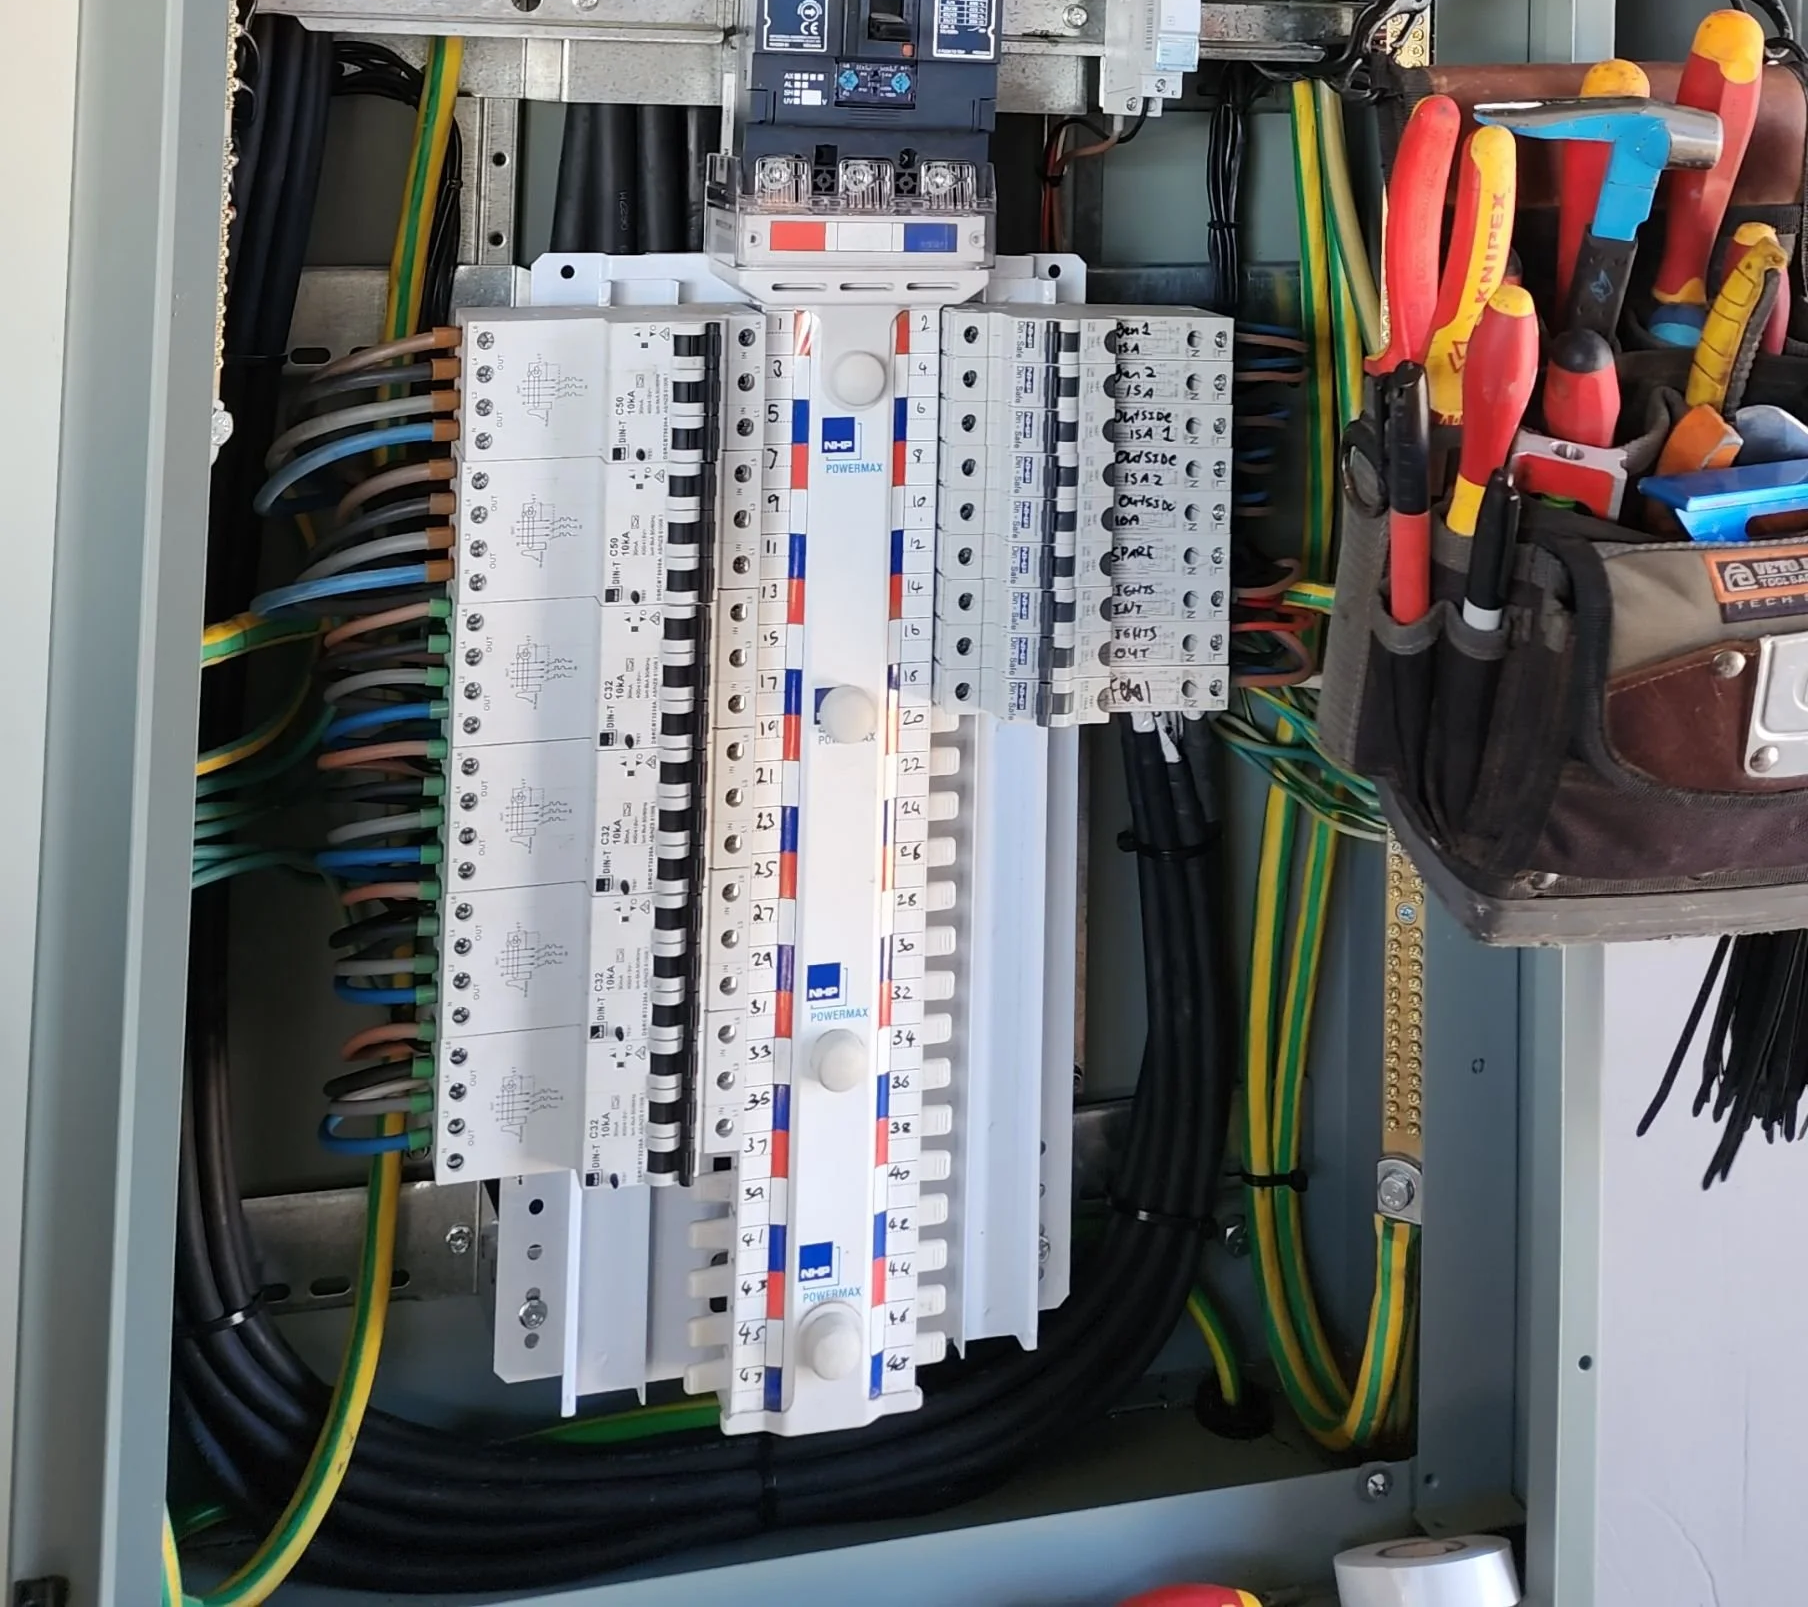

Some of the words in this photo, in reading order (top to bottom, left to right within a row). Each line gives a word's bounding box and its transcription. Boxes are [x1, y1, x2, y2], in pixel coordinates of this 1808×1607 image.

[800, 21, 819, 35] CE
[1475, 193, 1505, 303] KNIPEX
[921, 315, 930, 331] 2
[1143, 322, 1152, 336] 1
[773, 360, 782, 377] 3
[919, 361, 927, 375] 4
[1145, 367, 1157, 379] 2
[616, 396, 624, 416] C50
[627, 390, 636, 414] 10kA
[917, 403, 926, 414] 6
[768, 404, 780, 423] 5
[618, 420, 627, 443] DIN-T
[1162, 426, 1176, 442] 1
[824, 441, 852, 451] NHP
[767, 448, 778, 469] 7
[826, 462, 883, 474] POWERMAX
[1153, 473, 1163, 486] 2
[768, 494, 780, 512] 9
[912, 495, 926, 507] 10
[610, 537, 619, 557] C50
[621, 531, 631, 556] 10kA
[766, 540, 777, 554] 11
[910, 537, 926, 550] 12
[489, 553, 497, 569] OUT
[1110, 544, 1155, 562] SPARE
[612, 561, 621, 585] DIN-T
[1752, 559, 1800, 575] VETO
[907, 579, 924, 593] 14
[1760, 577, 1790, 587] TOOL
[762, 583, 778, 599] 13
[1113, 602, 1143, 615] INT
[1736, 596, 1794, 610] TECH
[764, 631, 779, 646] 15
[905, 624, 920, 638] 16
[1114, 647, 1150, 659] OUT
[604, 680, 613, 700] C32
[615, 674, 625, 699] 10kA
[761, 674, 778, 690] 17
[606, 705, 615, 728] DIN-T
[903, 710, 924, 725] 20
[760, 720, 779, 738] 19
[900, 758, 925, 772] 22
[756, 767, 773, 784] 21
[481, 780, 489, 797] OUT
[901, 801, 921, 814] 24
[756, 813, 775, 830] 23
[601, 825, 610, 845] C32
[612, 819, 622, 844] 10kA
[900, 843, 921, 860] 26
[603, 850, 611, 874] DIN-T
[755, 861, 777, 878] 25
[897, 893, 916, 905] 28
[753, 905, 774, 922] 27
[897, 938, 914, 953] 30
[752, 952, 774, 969] 29
[595, 972, 604, 992] C32
[606, 965, 616, 991] 10kA
[808, 986, 839, 999] NHP
[891, 985, 913, 1000] 32
[597, 997, 606, 1021] DIN-T
[750, 1000, 767, 1014] 31
[810, 1008, 869, 1022] POWERMAX
[892, 1031, 915, 1047] 34
[748, 1044, 772, 1060] 33
[469, 1069, 477, 1087] OUT
[891, 1075, 910, 1089] 36
[744, 1091, 770, 1111] 35
[589, 1119, 599, 1139] C32
[601, 1112, 610, 1137] 10kA
[890, 1121, 911, 1134] 38
[744, 1137, 767, 1155] 37
[592, 1144, 600, 1169] DIN-T
[888, 1166, 910, 1181] 40
[744, 1186, 764, 1201] 39
[888, 1218, 910, 1231] 42
[742, 1228, 764, 1244] 41
[800, 1266, 830, 1279] NHP
[888, 1261, 910, 1275] 44
[803, 1287, 862, 1303] POWERMAX
[738, 1325, 765, 1345] 45
[740, 1367, 762, 1383] 47
